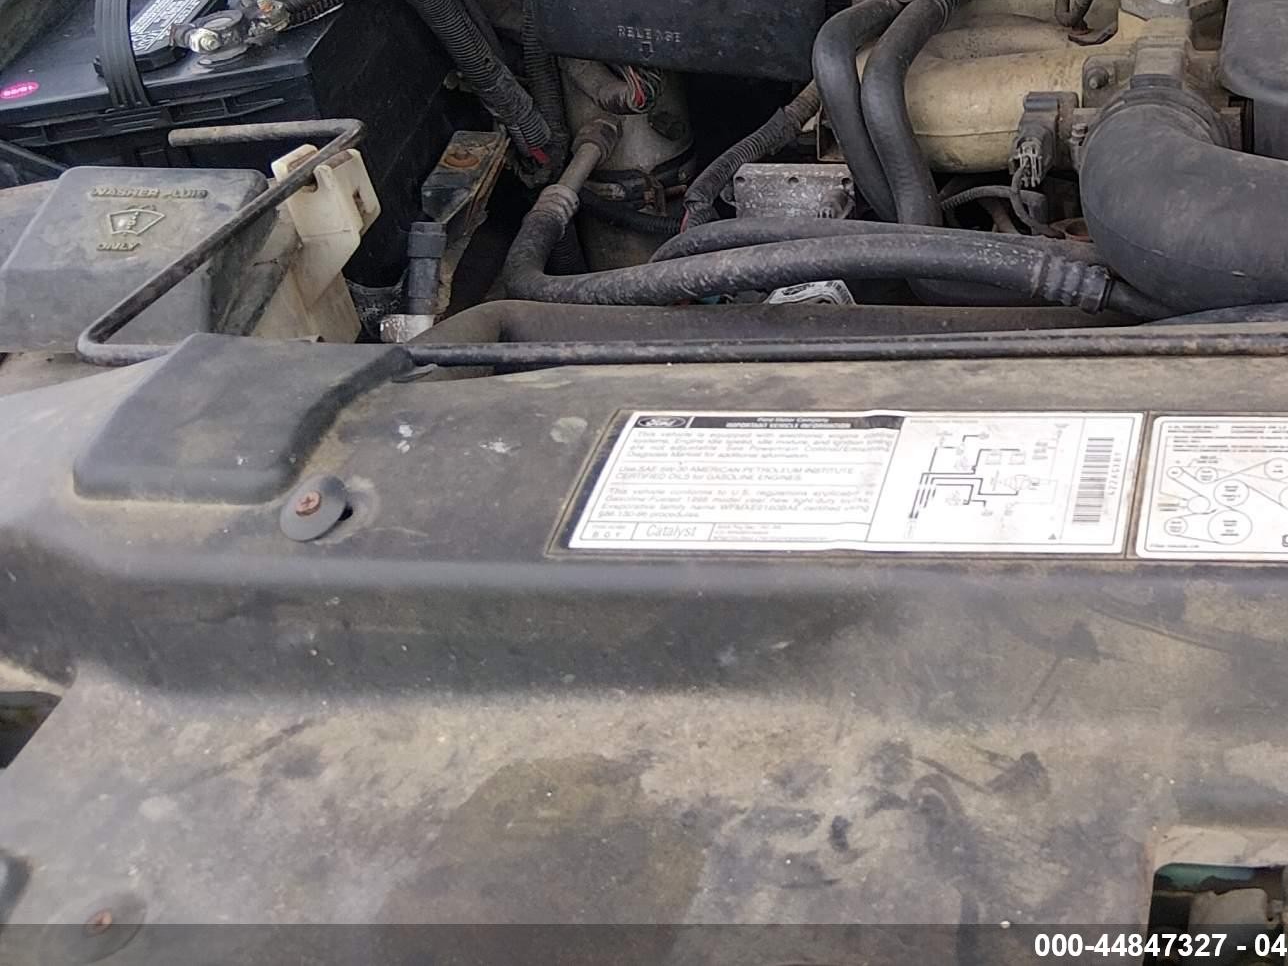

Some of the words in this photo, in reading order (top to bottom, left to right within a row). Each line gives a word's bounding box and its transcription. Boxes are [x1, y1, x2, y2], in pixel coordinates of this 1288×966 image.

[617, 24, 681, 43] RELEASE
[90, 187, 161, 199] WASHER
[97, 242, 141, 251] ONLY
[645, 523, 698, 539] Catalyst
